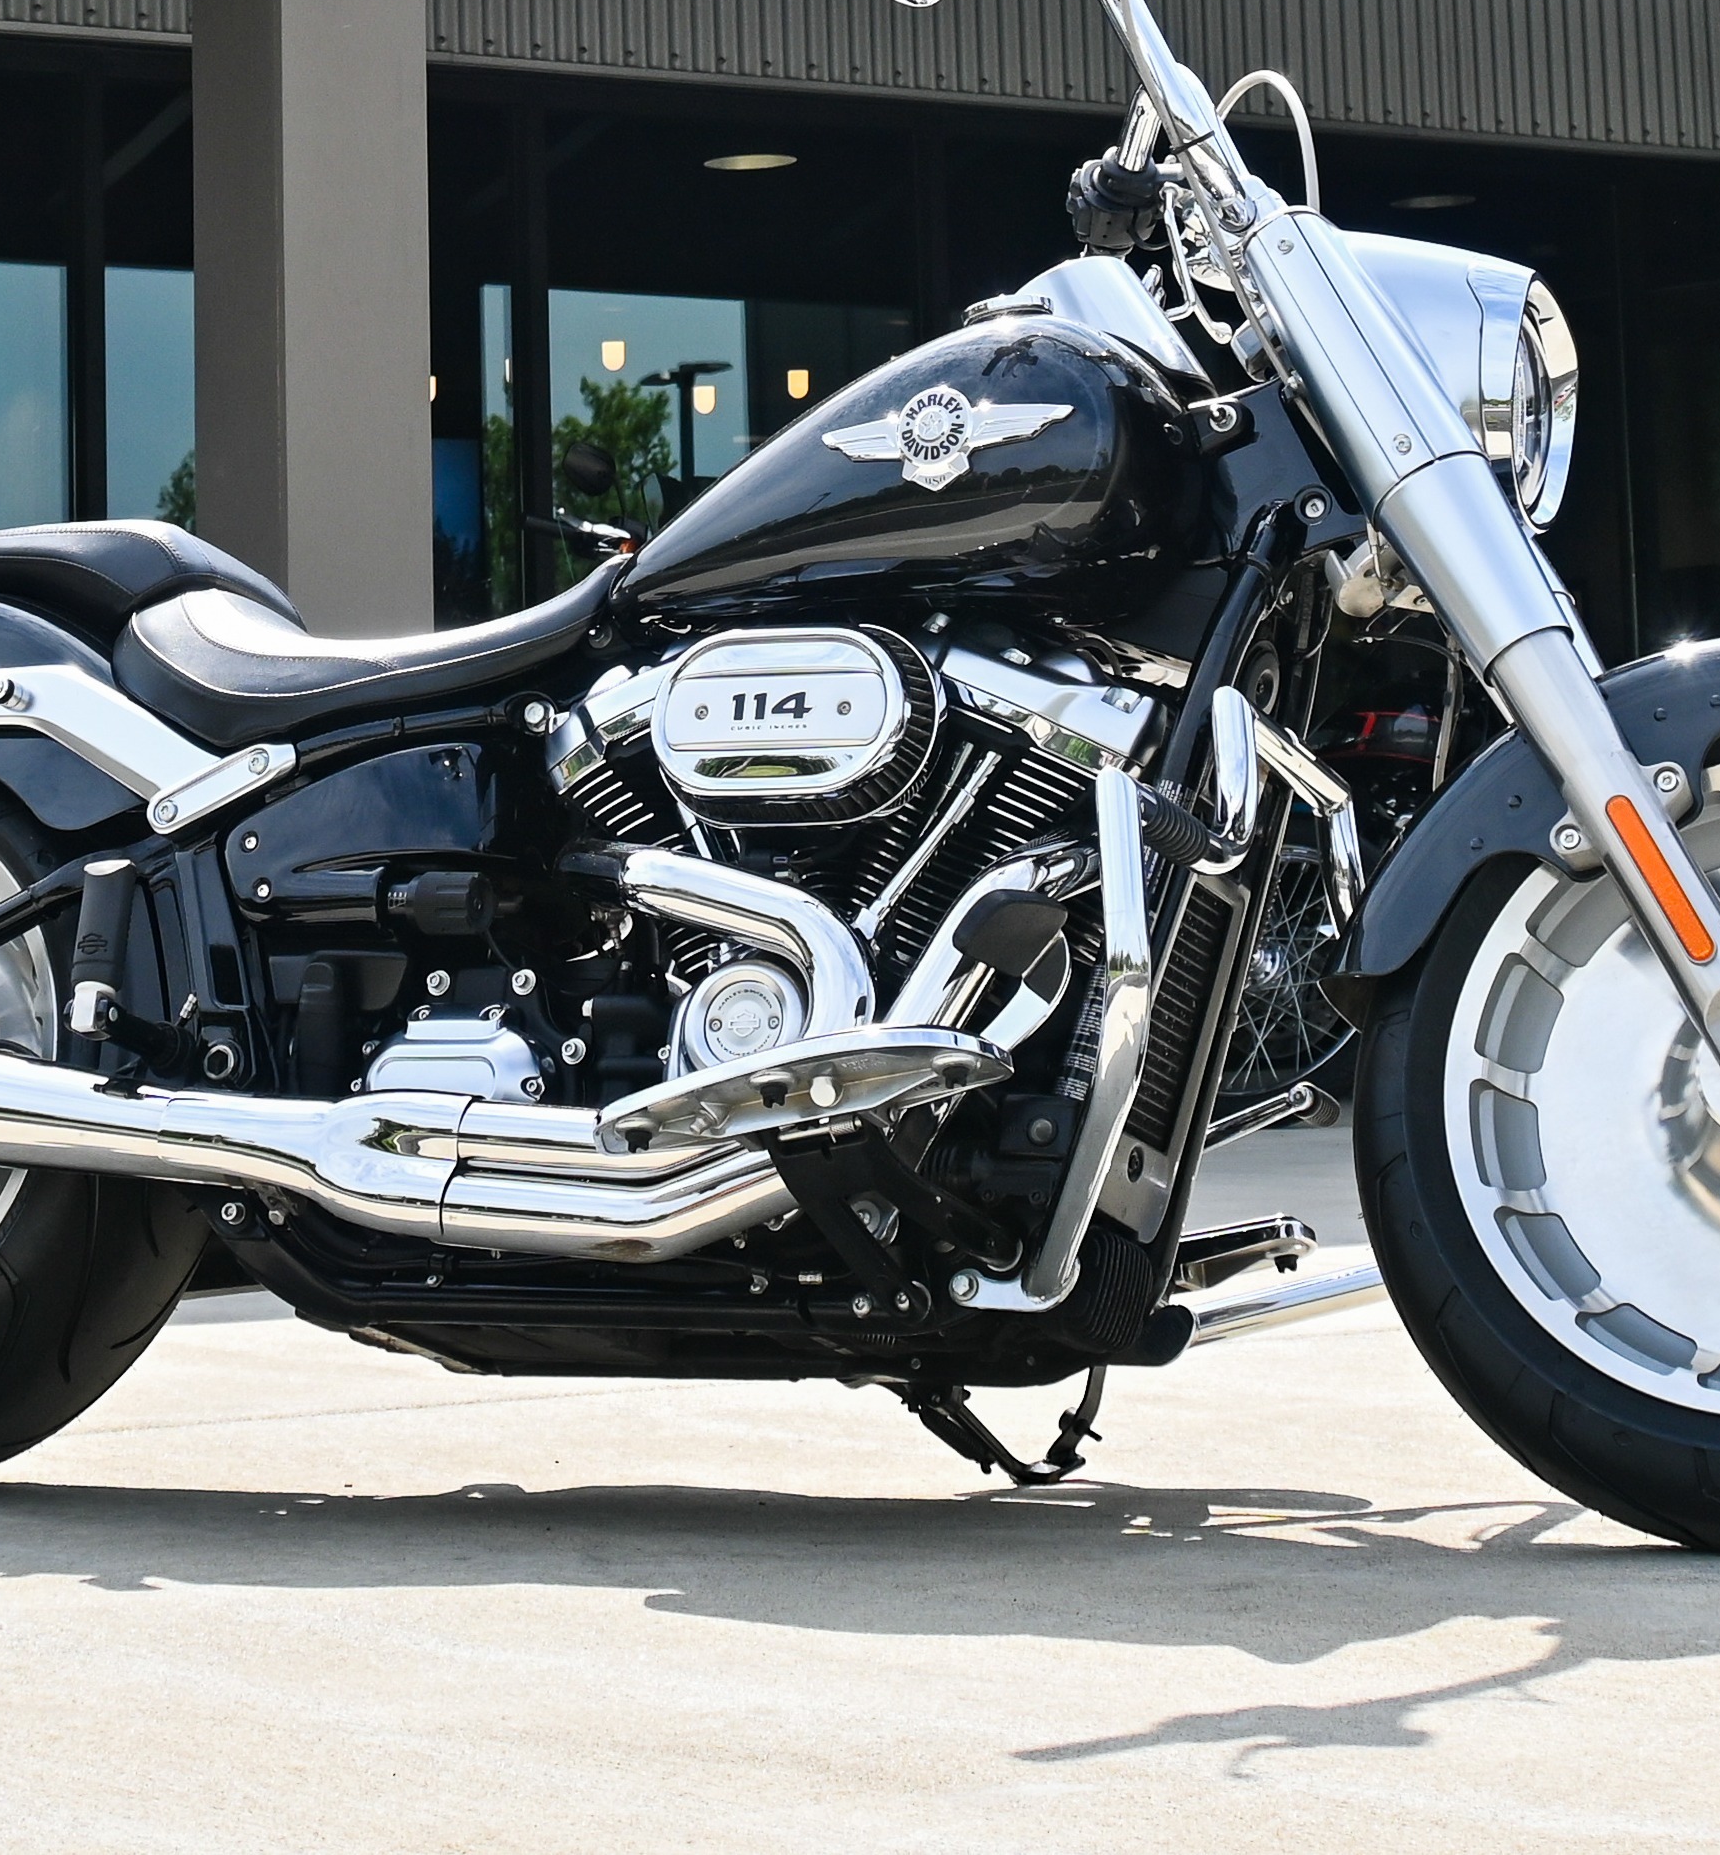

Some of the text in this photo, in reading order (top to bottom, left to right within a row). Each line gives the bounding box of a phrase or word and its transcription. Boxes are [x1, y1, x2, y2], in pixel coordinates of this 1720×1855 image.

[905, 393, 963, 420] HARLEY
[901, 423, 965, 460] DAVIDSON
[732, 691, 813, 721] 114
